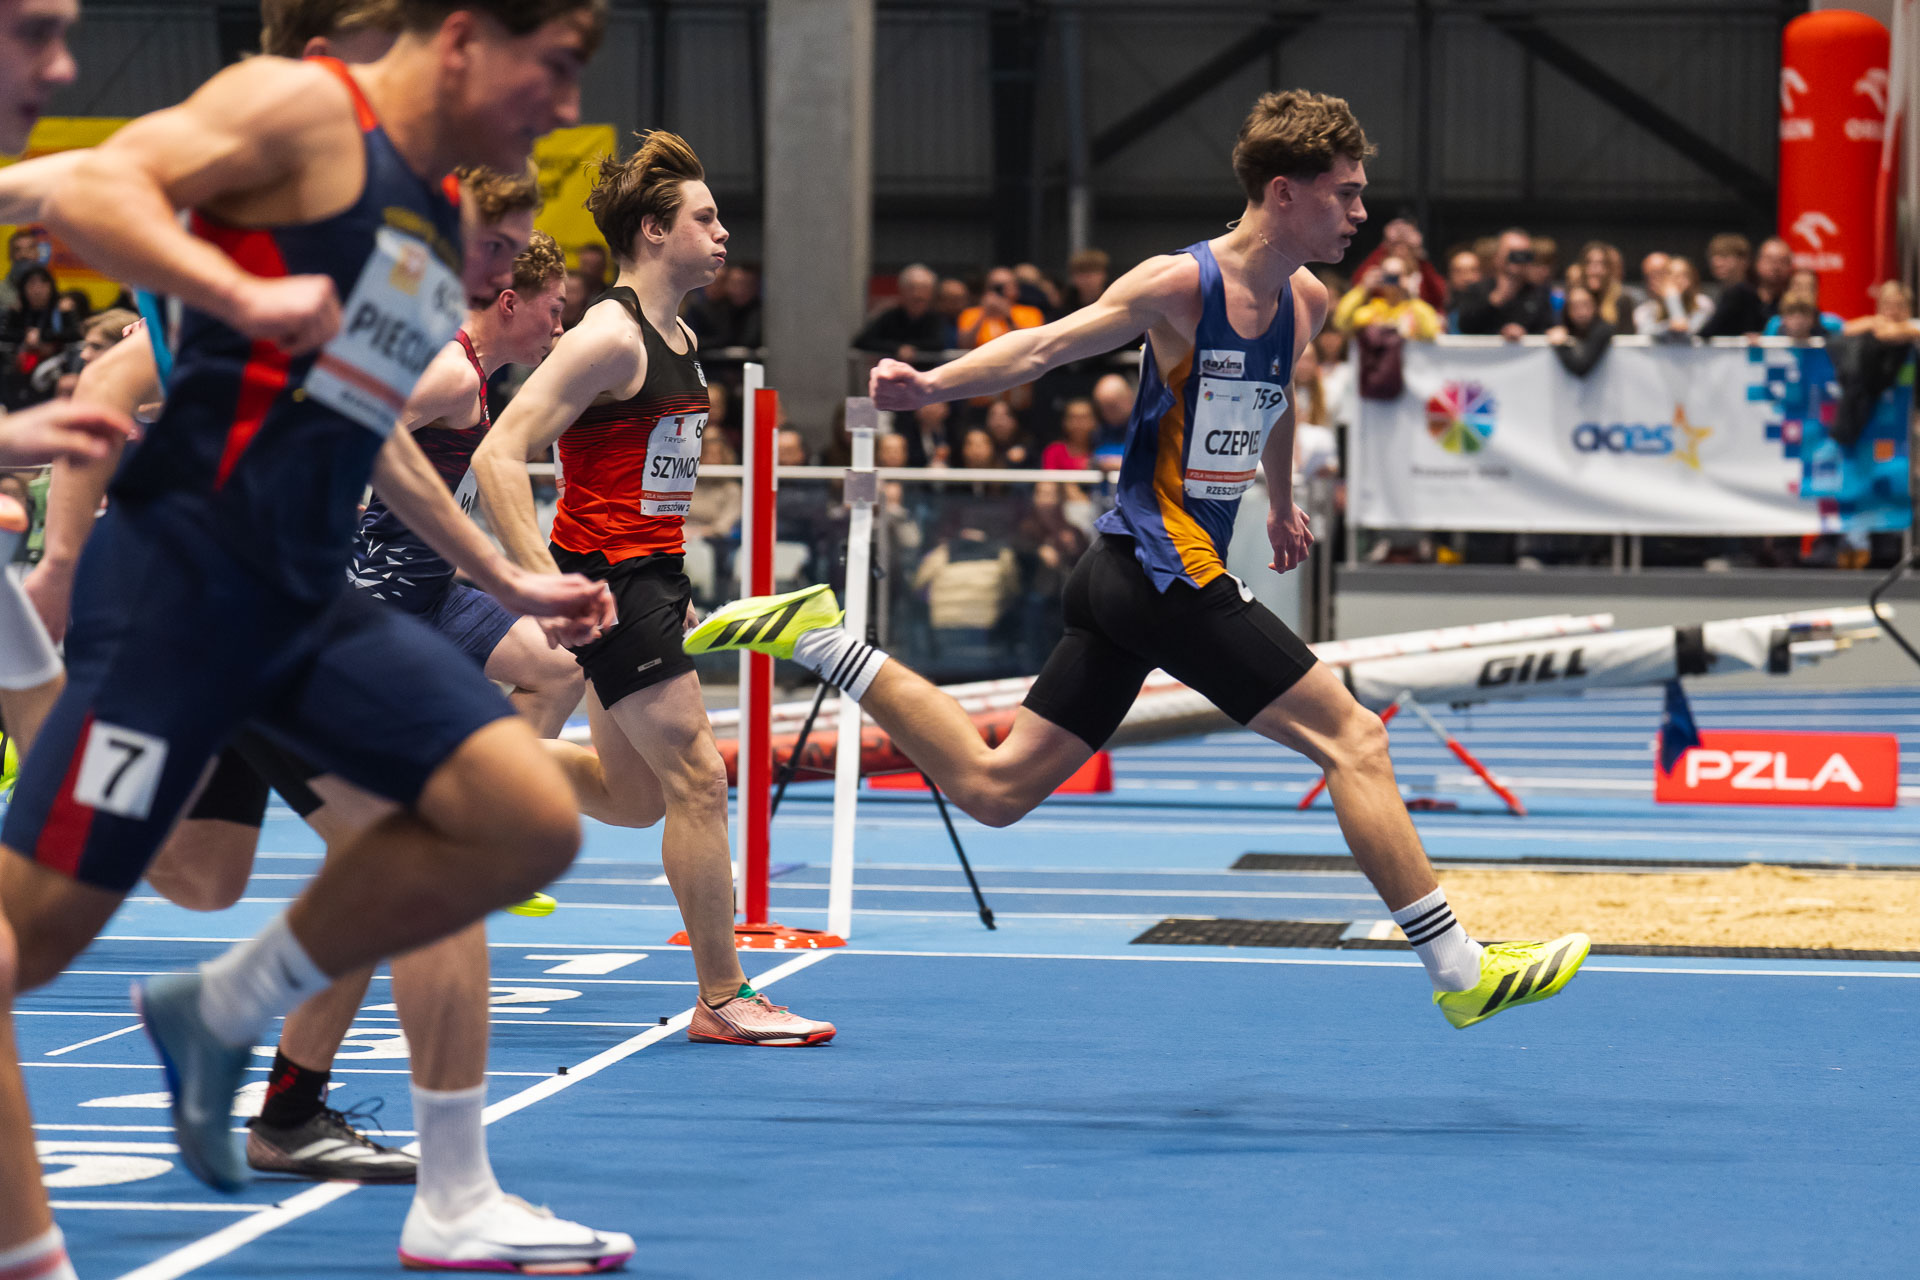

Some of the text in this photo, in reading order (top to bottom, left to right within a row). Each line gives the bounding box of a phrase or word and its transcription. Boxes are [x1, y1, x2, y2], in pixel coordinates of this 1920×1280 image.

[1477, 648, 1588, 688] GILL
[105, 738, 145, 800] 7
[1685, 748, 1864, 793] PZLA
